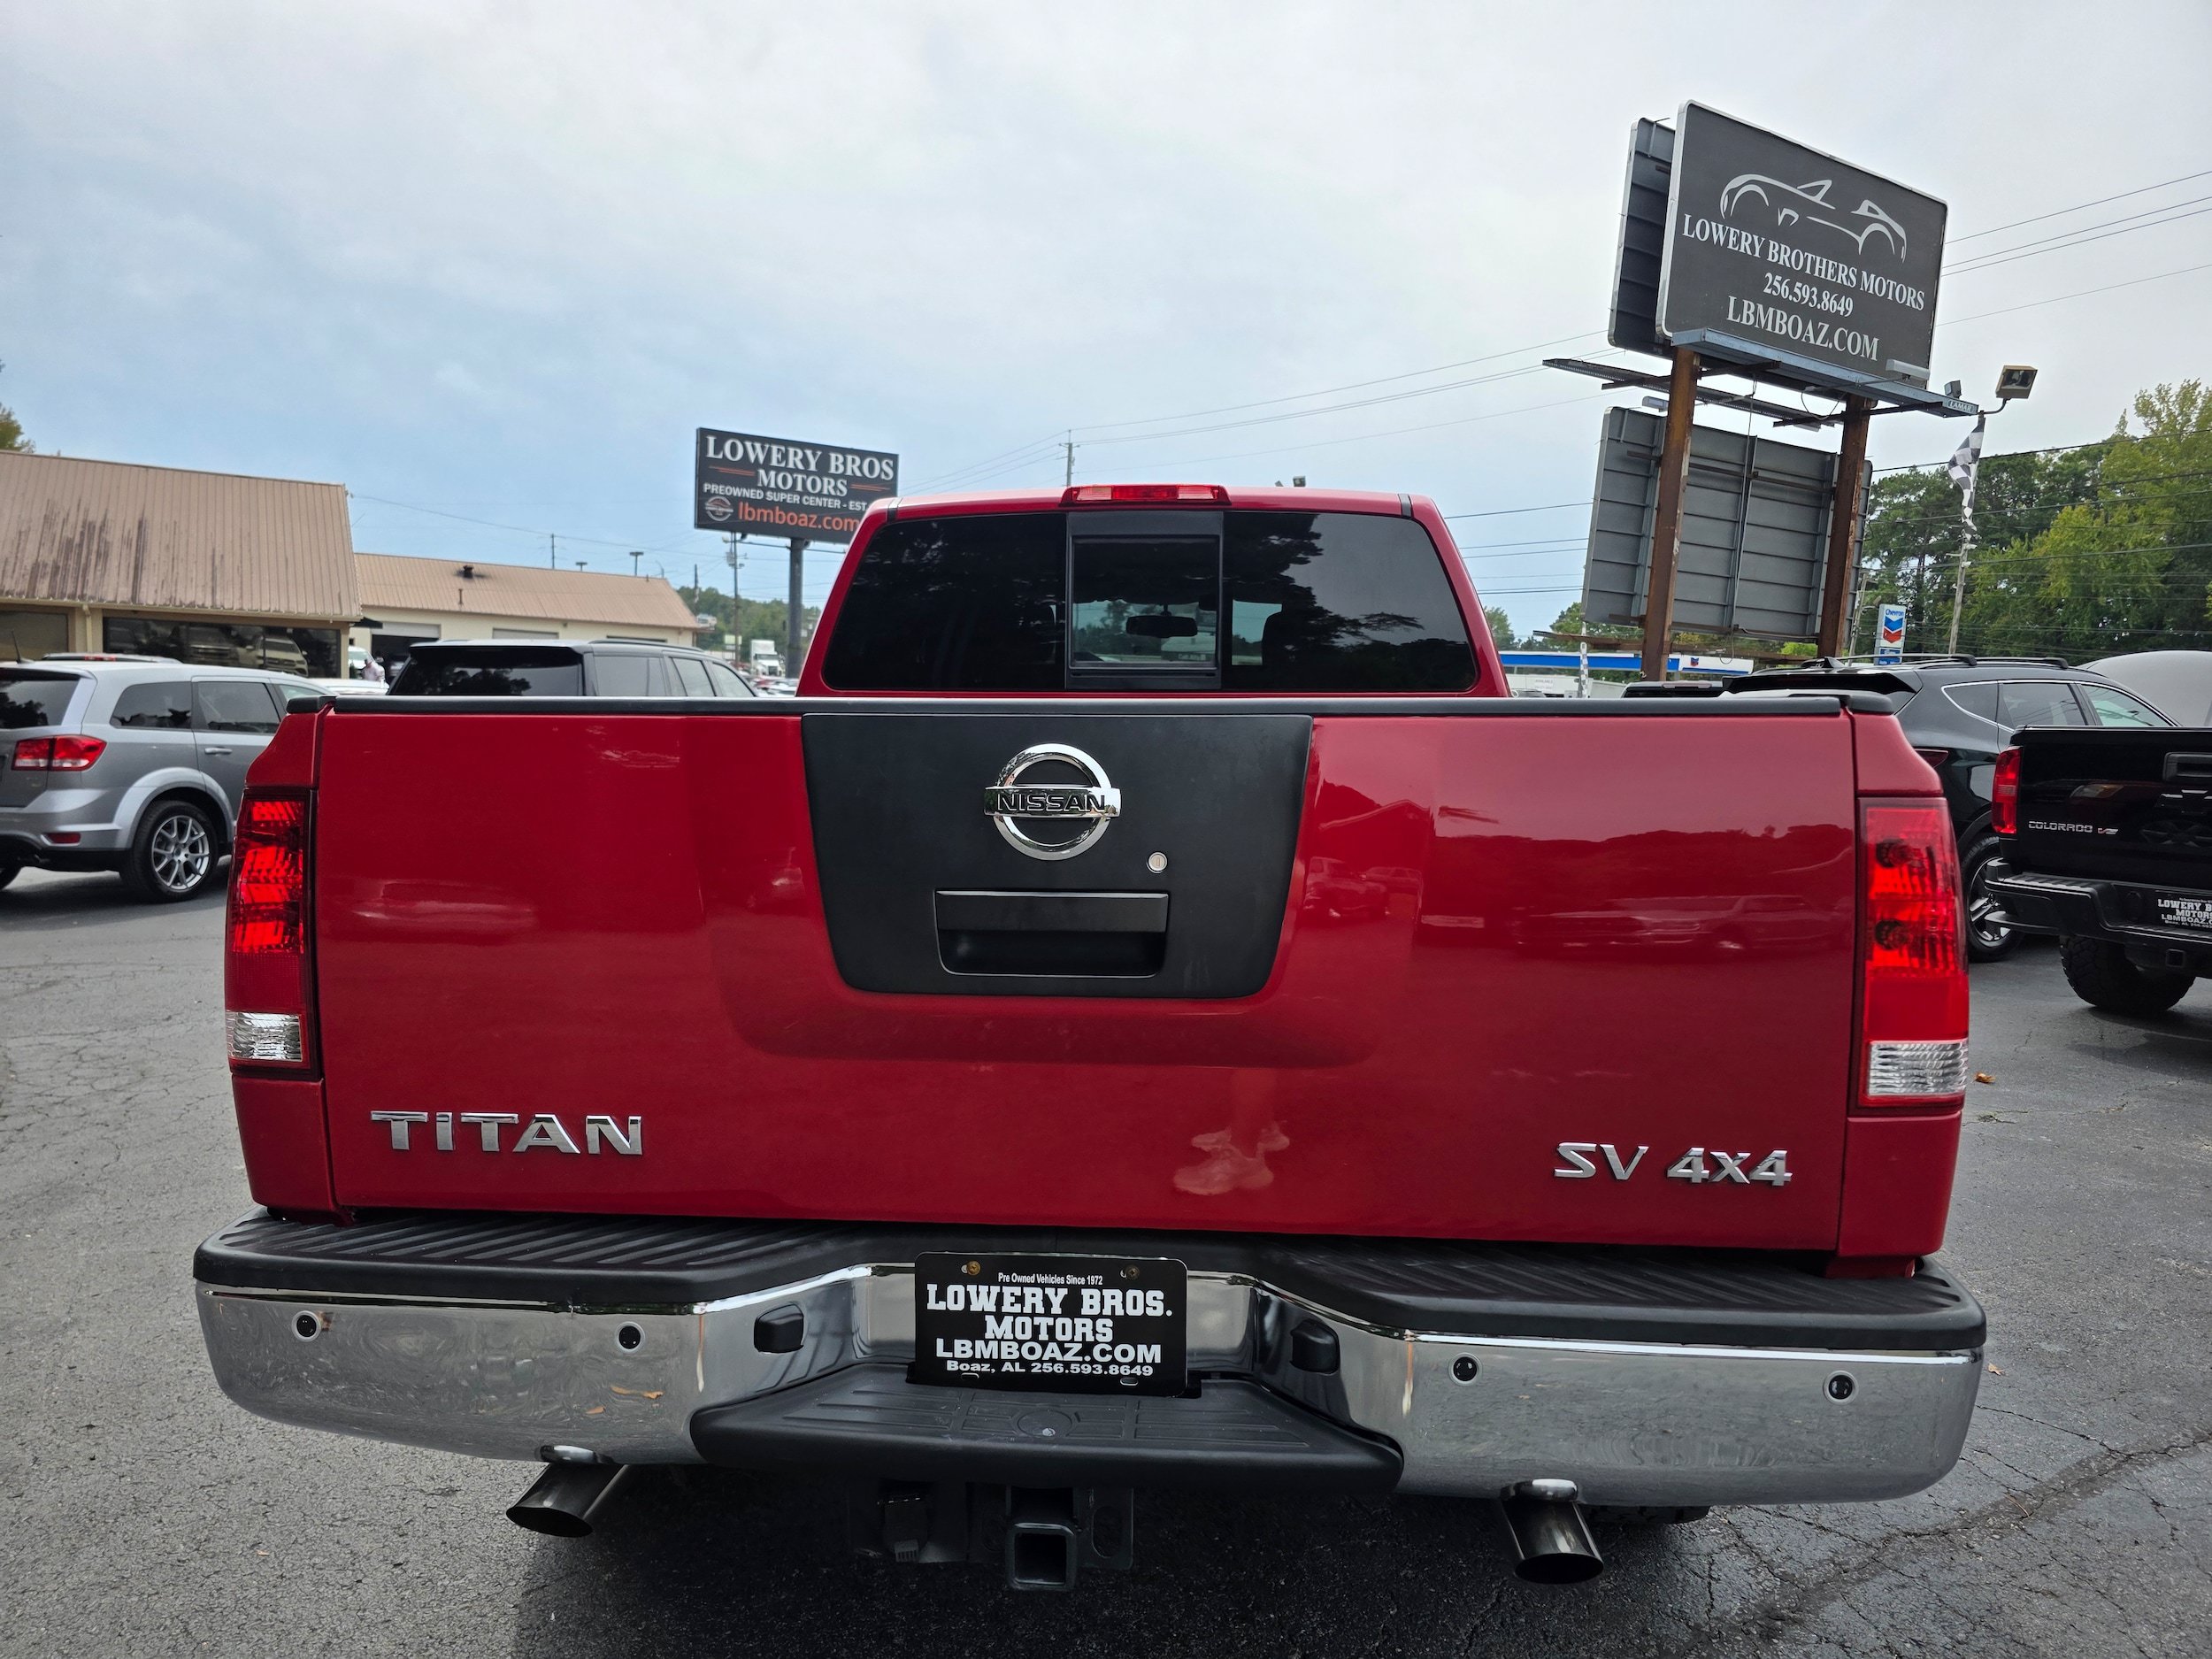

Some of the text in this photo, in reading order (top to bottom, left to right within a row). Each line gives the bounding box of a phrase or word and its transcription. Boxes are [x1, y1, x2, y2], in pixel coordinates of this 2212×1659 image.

[1683, 214, 1925, 311] LOWERY BROTHERS MOTORS
[1763, 273, 1854, 317] 256.593.8649
[1726, 296, 1879, 362] LBMBOAZ.COM
[1950, 401, 1972, 413] LAMAR
[706, 435, 894, 480] LOWERY BROS
[703, 483, 764, 500] PREOWNED
[766, 491, 800, 504] SUPER
[803, 495, 841, 510] CENTER
[757, 469, 848, 497] MOTORS
[738, 502, 861, 532] lbmboaz.com
[997, 793, 1106, 812] NISSAN
[2028, 821, 2093, 833] COLORADO
[2158, 899, 2201, 910] LOWERY
[370, 1110, 643, 1156] TITAN
[1554, 1142, 1649, 1180] SV
[998, 1272, 1103, 1286] Pre Owned Vehicles Since 1972
[927, 1284, 1172, 1317] LOWERY BROS.
[985, 1315, 1113, 1342] MOTORS
[936, 1338, 1162, 1363] LBMBOAZ.COM
[947, 1360, 1154, 1377] Boaz, AL 256.593.8649
